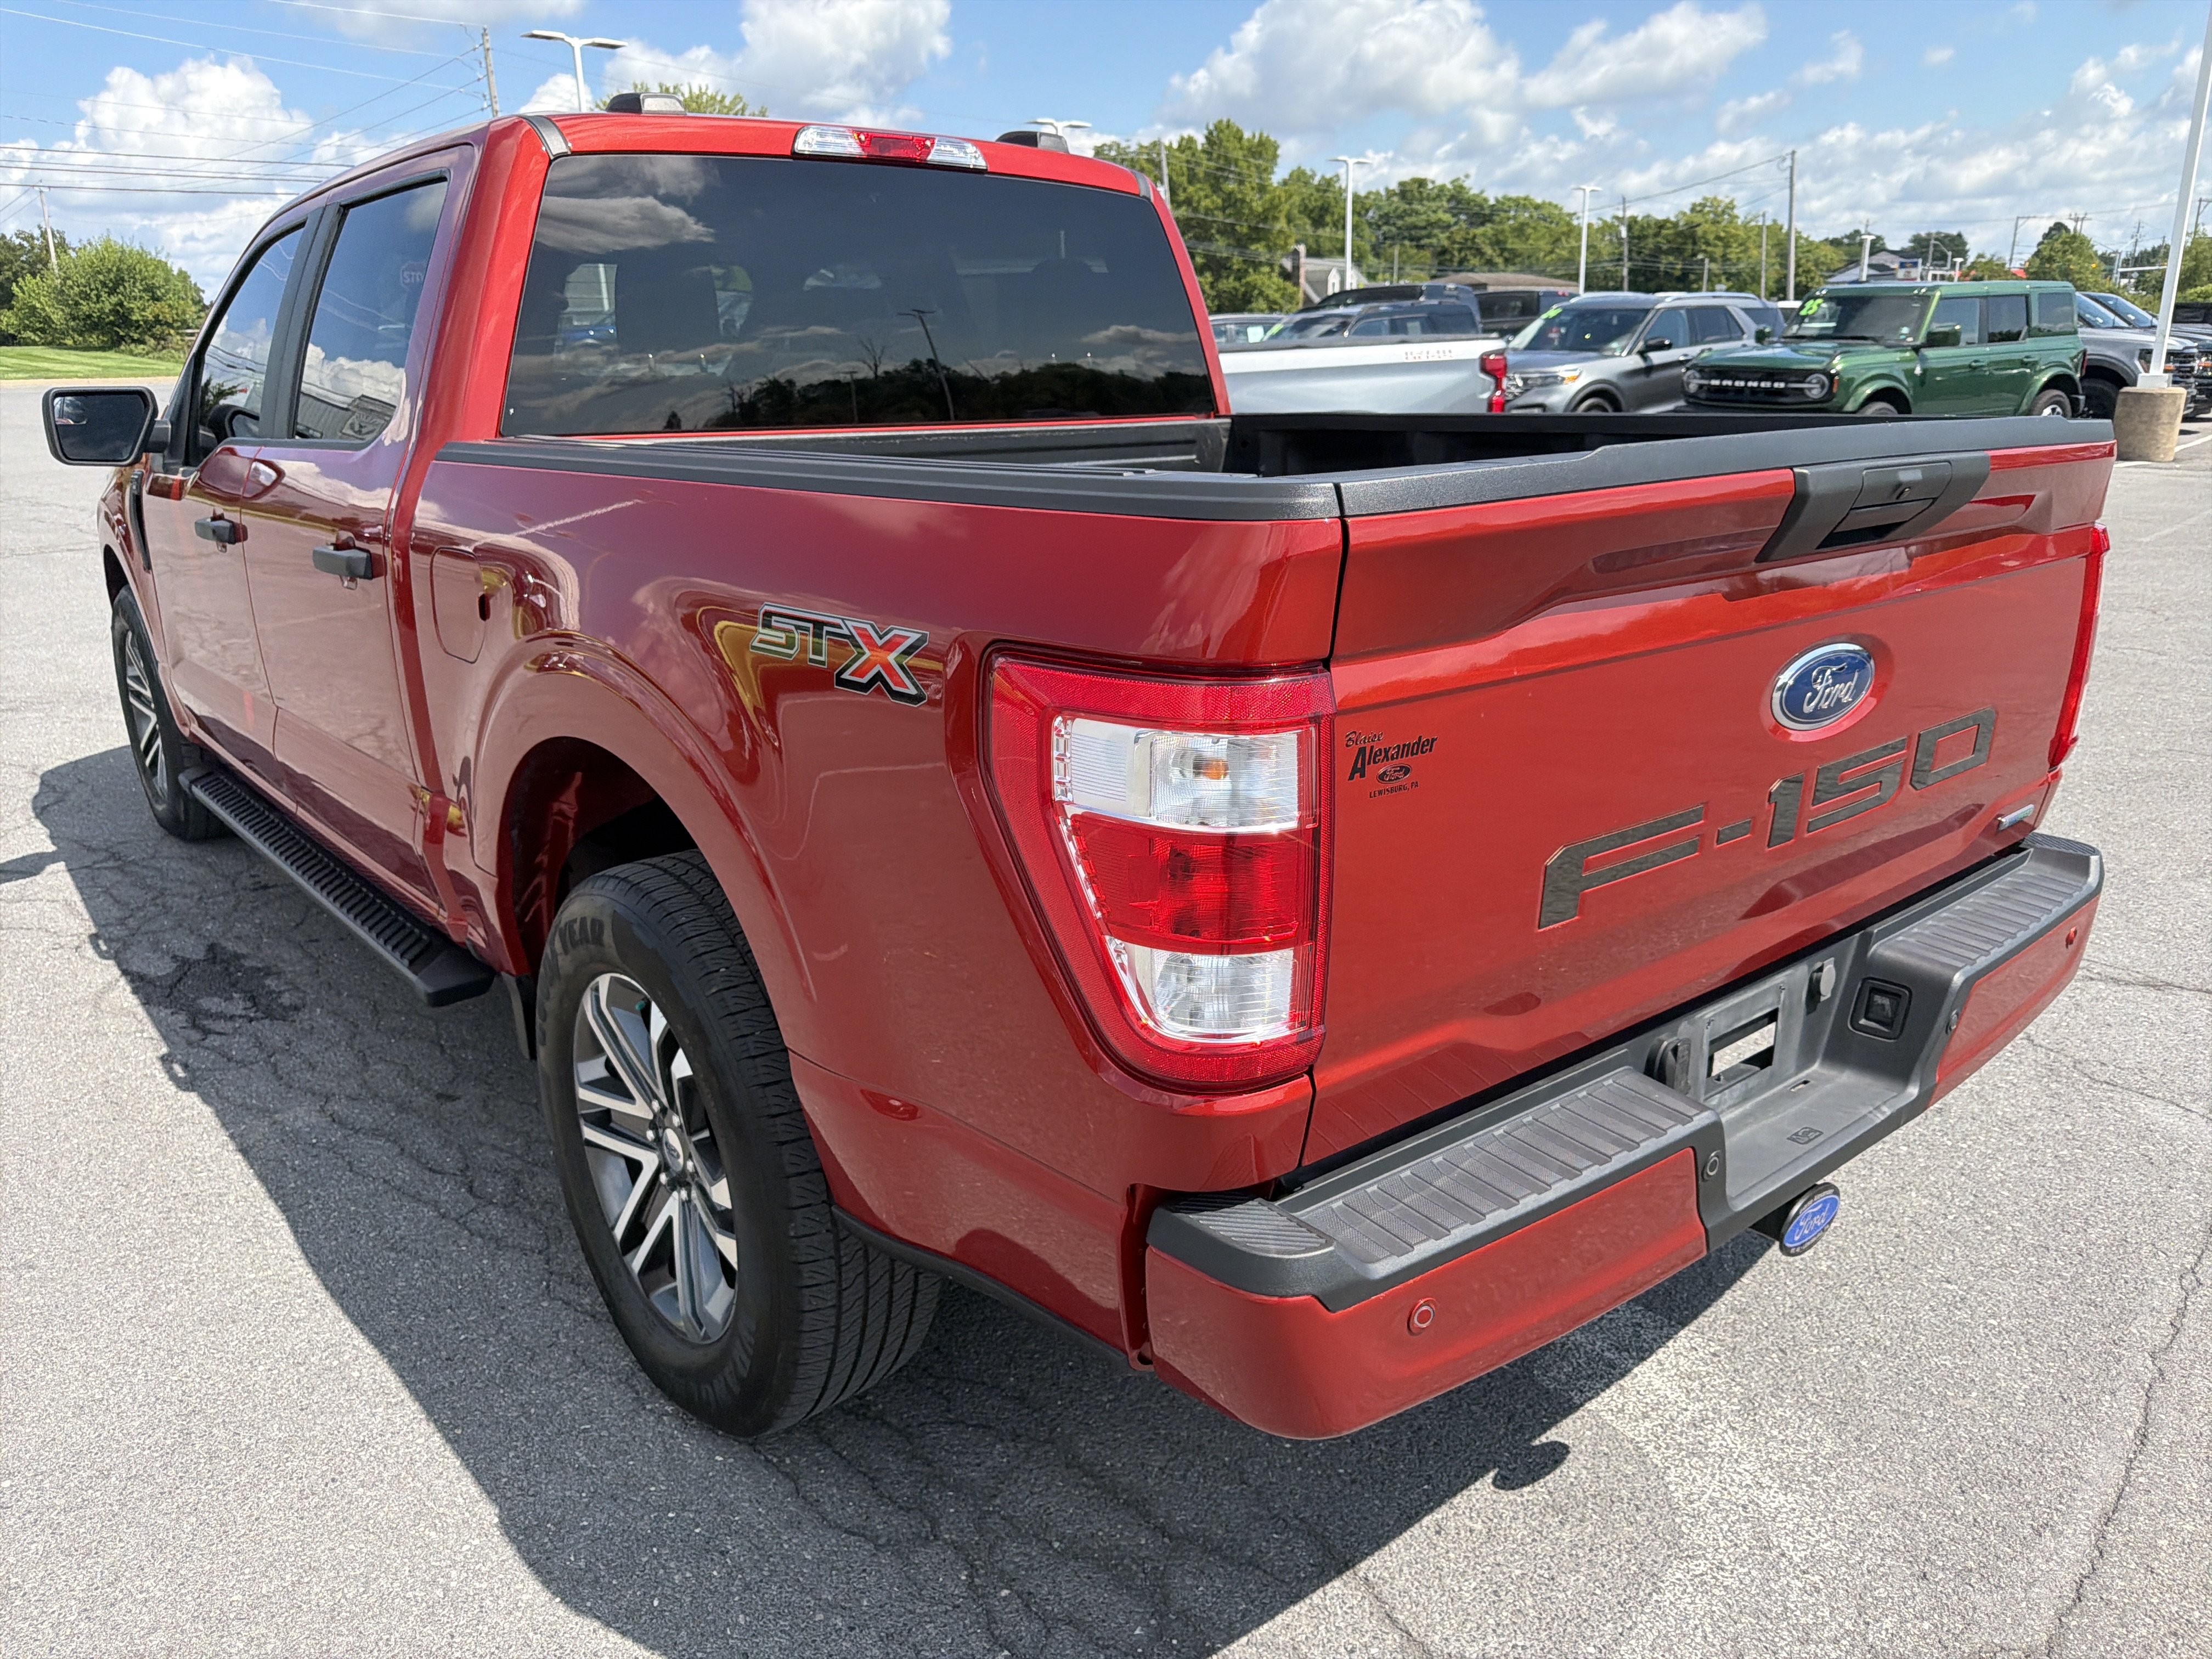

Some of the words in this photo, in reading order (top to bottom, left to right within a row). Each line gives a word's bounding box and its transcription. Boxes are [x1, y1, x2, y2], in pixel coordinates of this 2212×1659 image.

[403, 272, 424, 283] STO
[1710, 379, 1785, 388] BRONCO
[750, 602, 929, 707] STX
[1345, 730, 1384, 748] Blaise
[1347, 735, 1438, 781] Alexander
[1369, 784, 1410, 798] LEWISBURG,
[1410, 781, 1419, 789] PA
[1538, 707, 1996, 930] F-150
